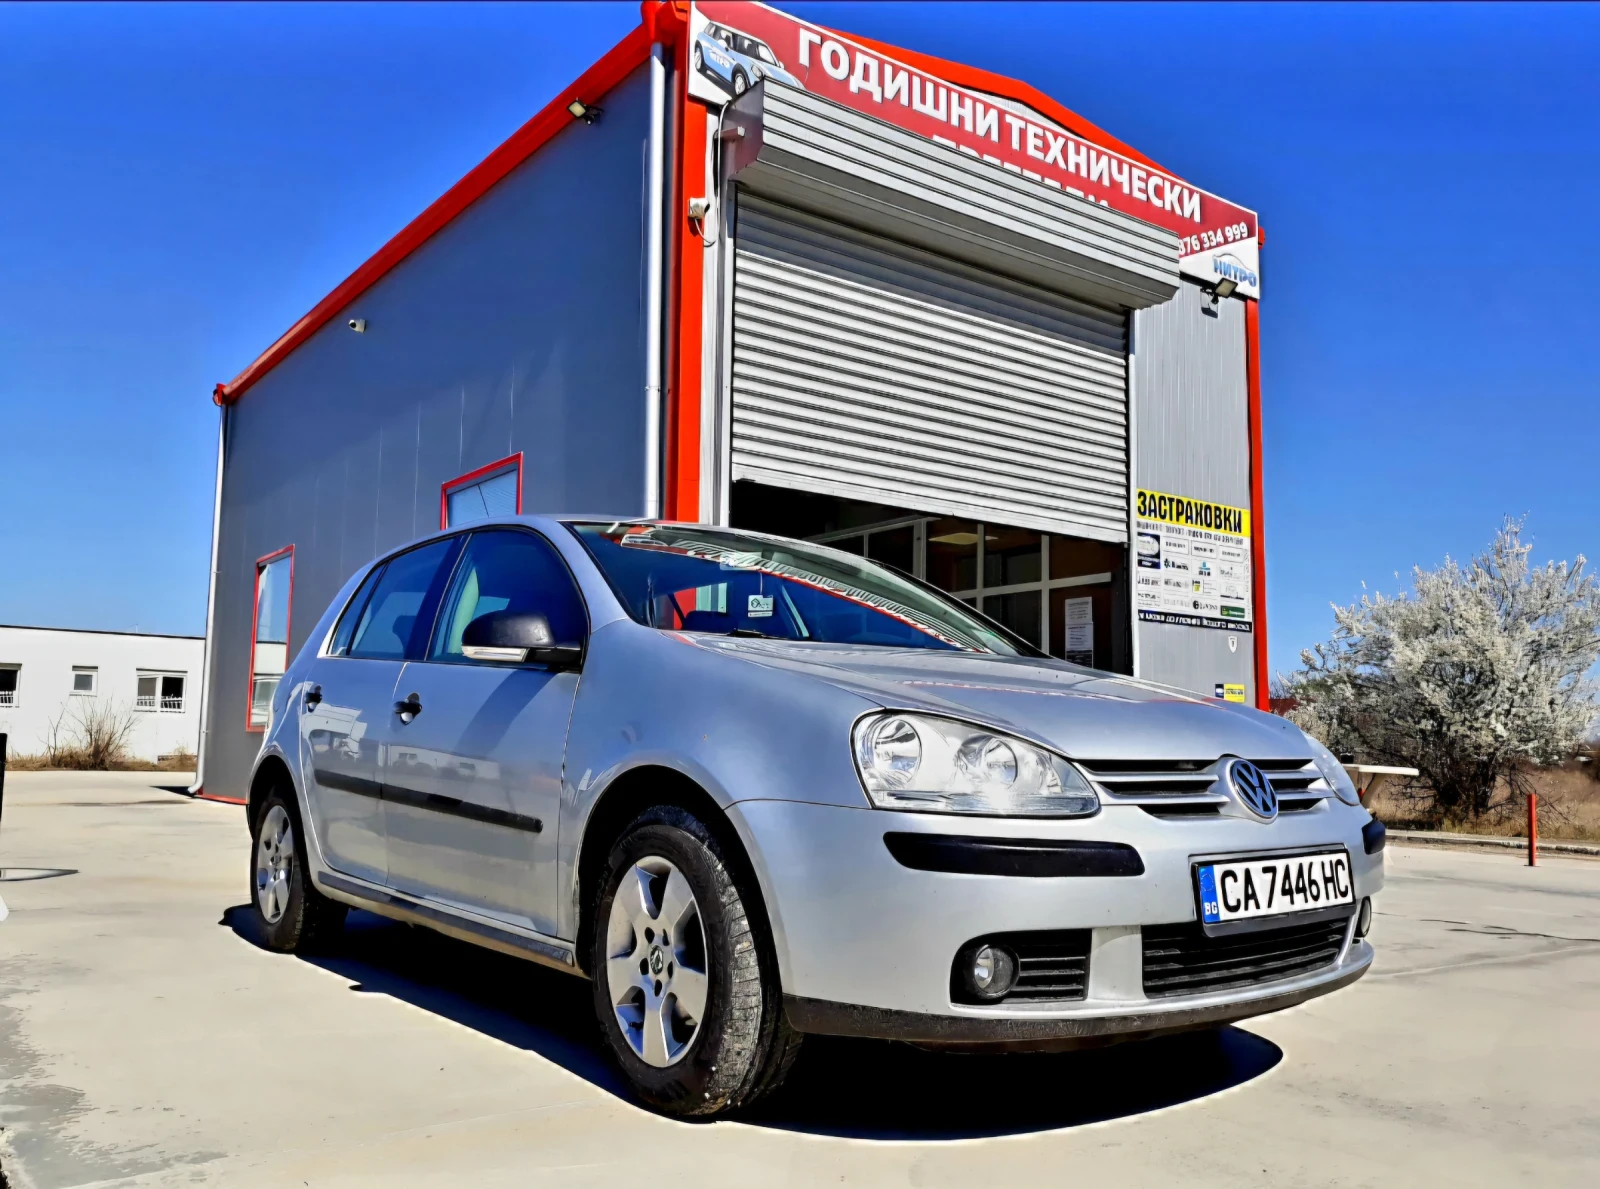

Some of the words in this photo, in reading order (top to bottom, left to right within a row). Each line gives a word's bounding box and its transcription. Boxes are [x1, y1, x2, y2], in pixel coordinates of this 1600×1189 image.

[798, 27, 999, 143] ГОДИШНИ
[1004, 116, 1202, 224] ТЕХНИЧЕСКИ
[1200, 230, 1225, 249] 334
[1224, 221, 1248, 242] 999
[1137, 491, 1242, 533] ЗАСТРАХОВКИ
[1204, 902, 1219, 915] BG
